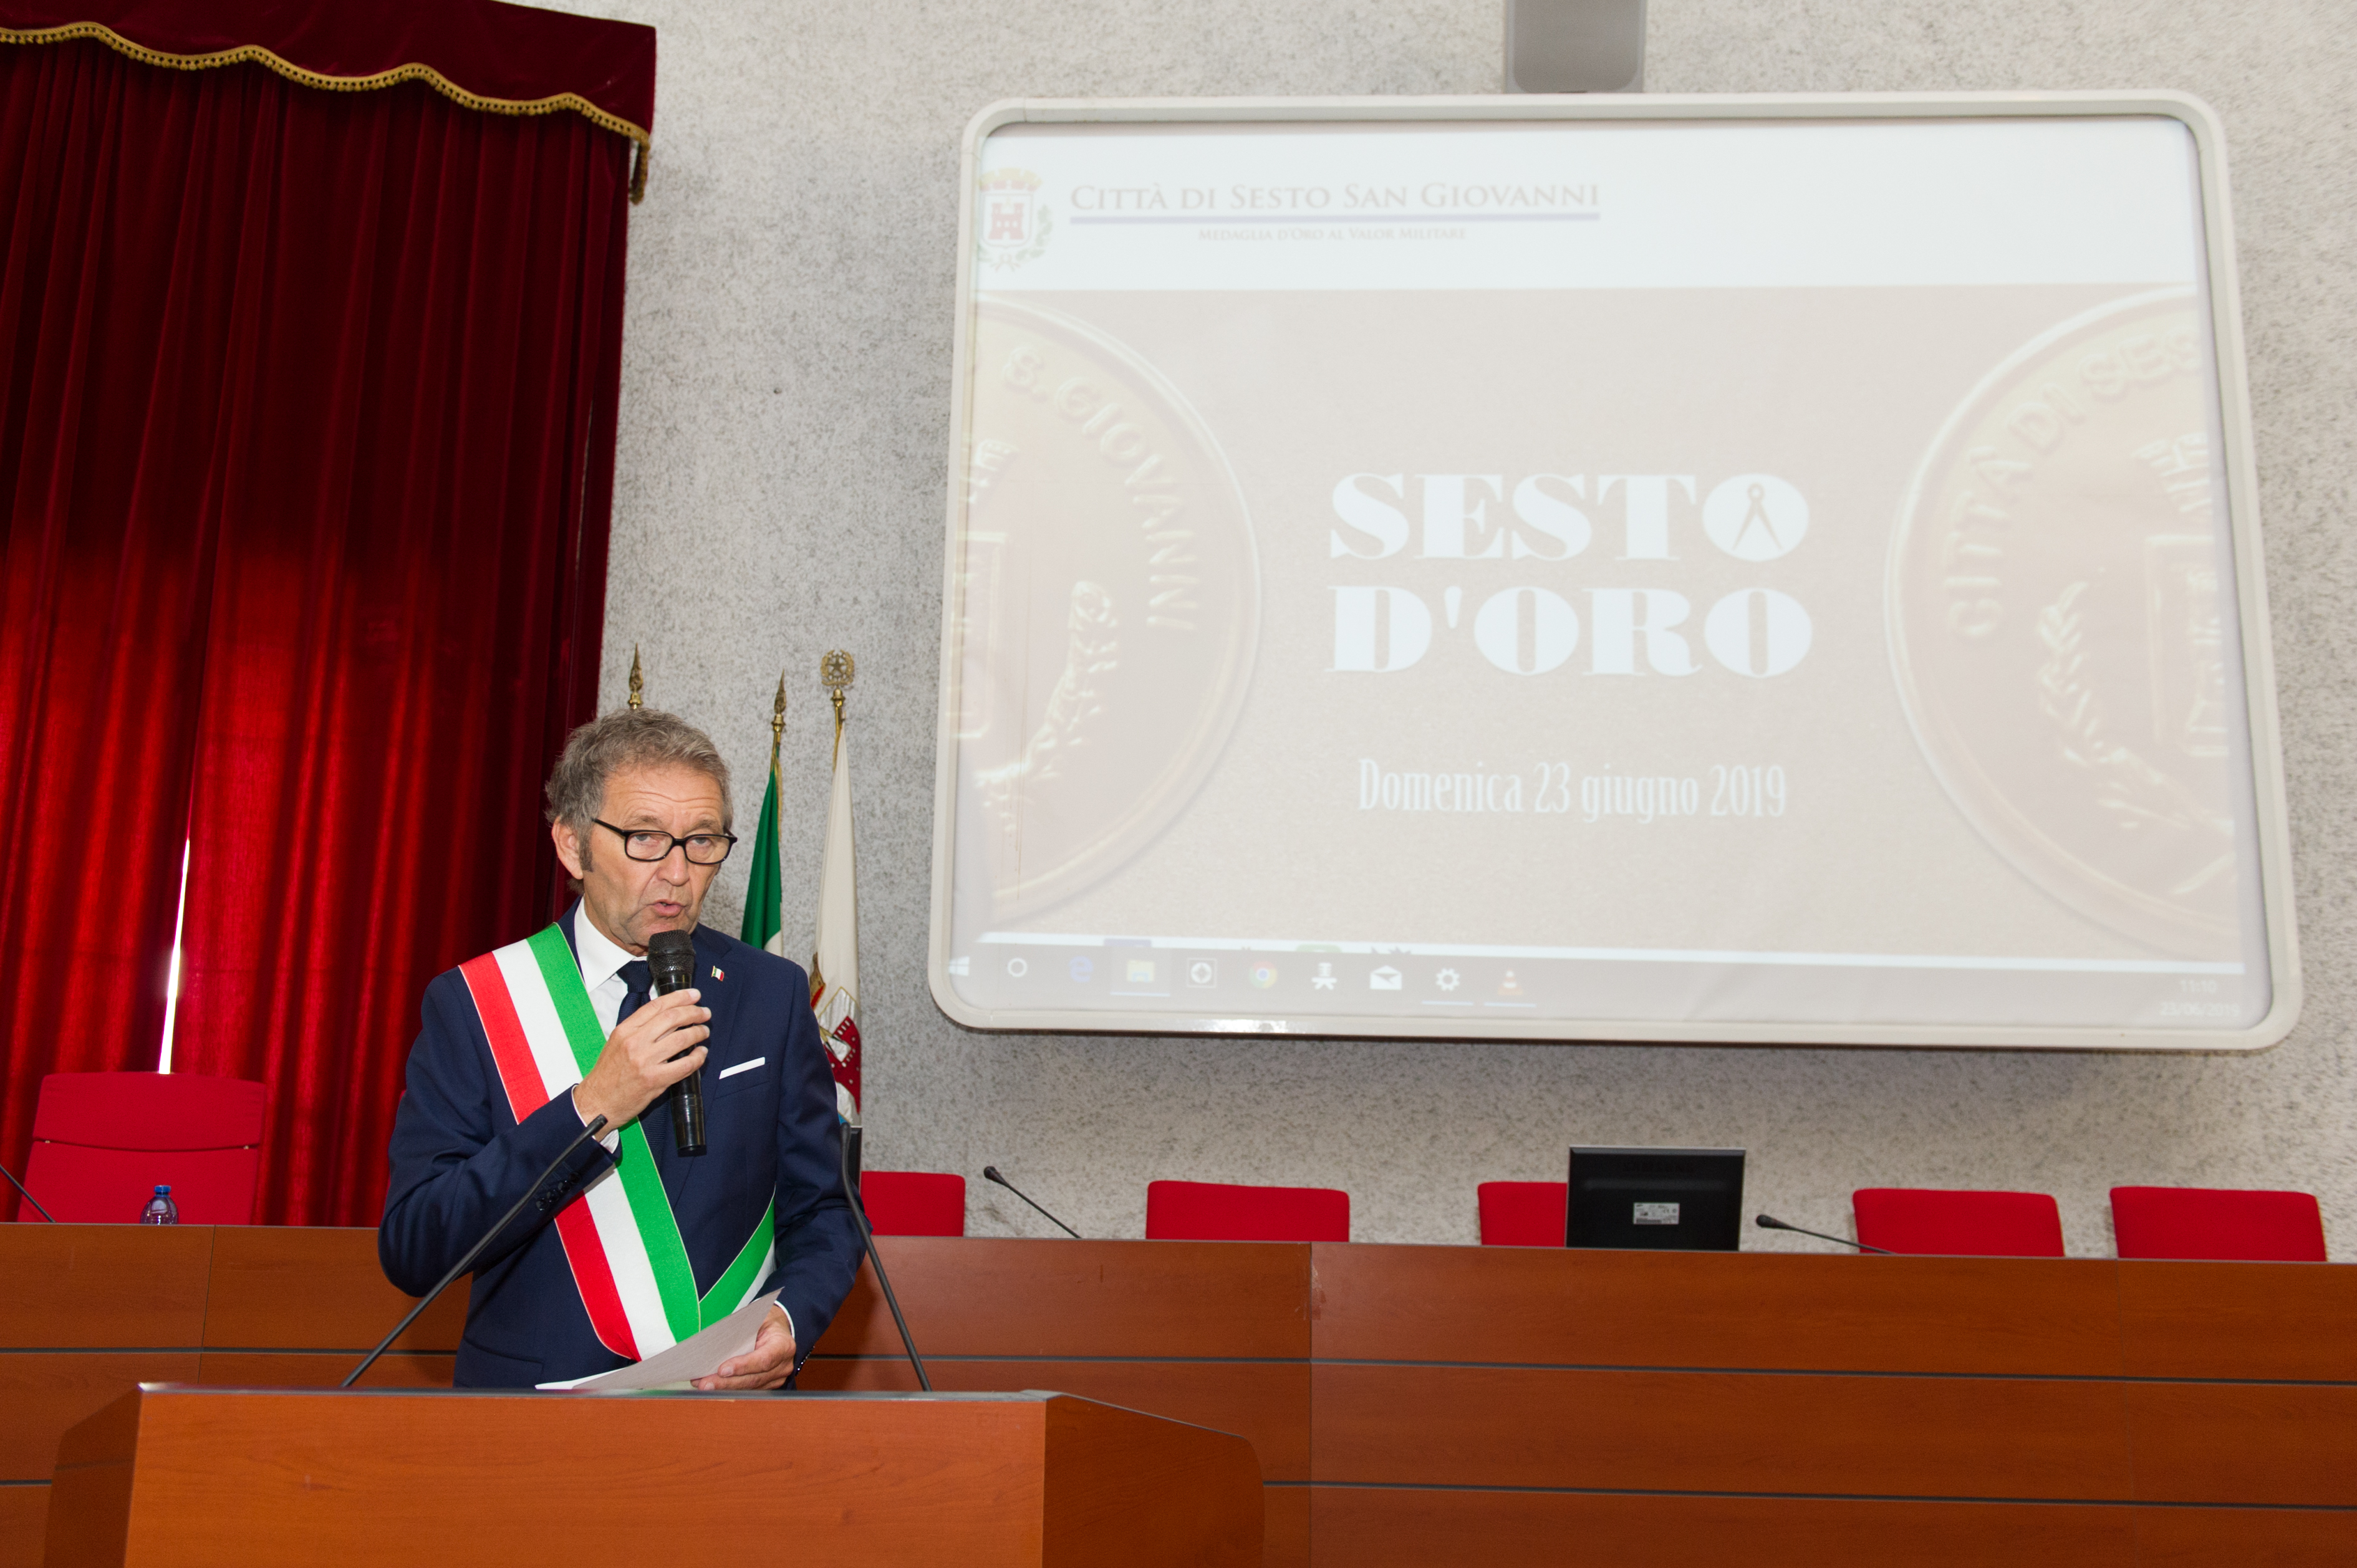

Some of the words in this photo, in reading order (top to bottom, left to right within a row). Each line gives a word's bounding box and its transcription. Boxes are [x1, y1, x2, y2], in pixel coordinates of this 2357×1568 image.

[1230, 184, 1331, 209] SESTO
[1343, 183, 1407, 209] SAN
[1420, 182, 1600, 208] GIOVANNI
[1198, 229, 1273, 241] MEDAGLIA
[1349, 228, 1394, 240] VALOR
[1399, 228, 1466, 240] MILITARE
[1330, 472, 1810, 562] SESTO
[1323, 585, 1814, 678] D'ORO
[1357, 758, 1523, 813] Domenica
[1534, 762, 1571, 814] 23
[1581, 762, 1699, 824] giugno
[1709, 764, 1788, 818] 2019
